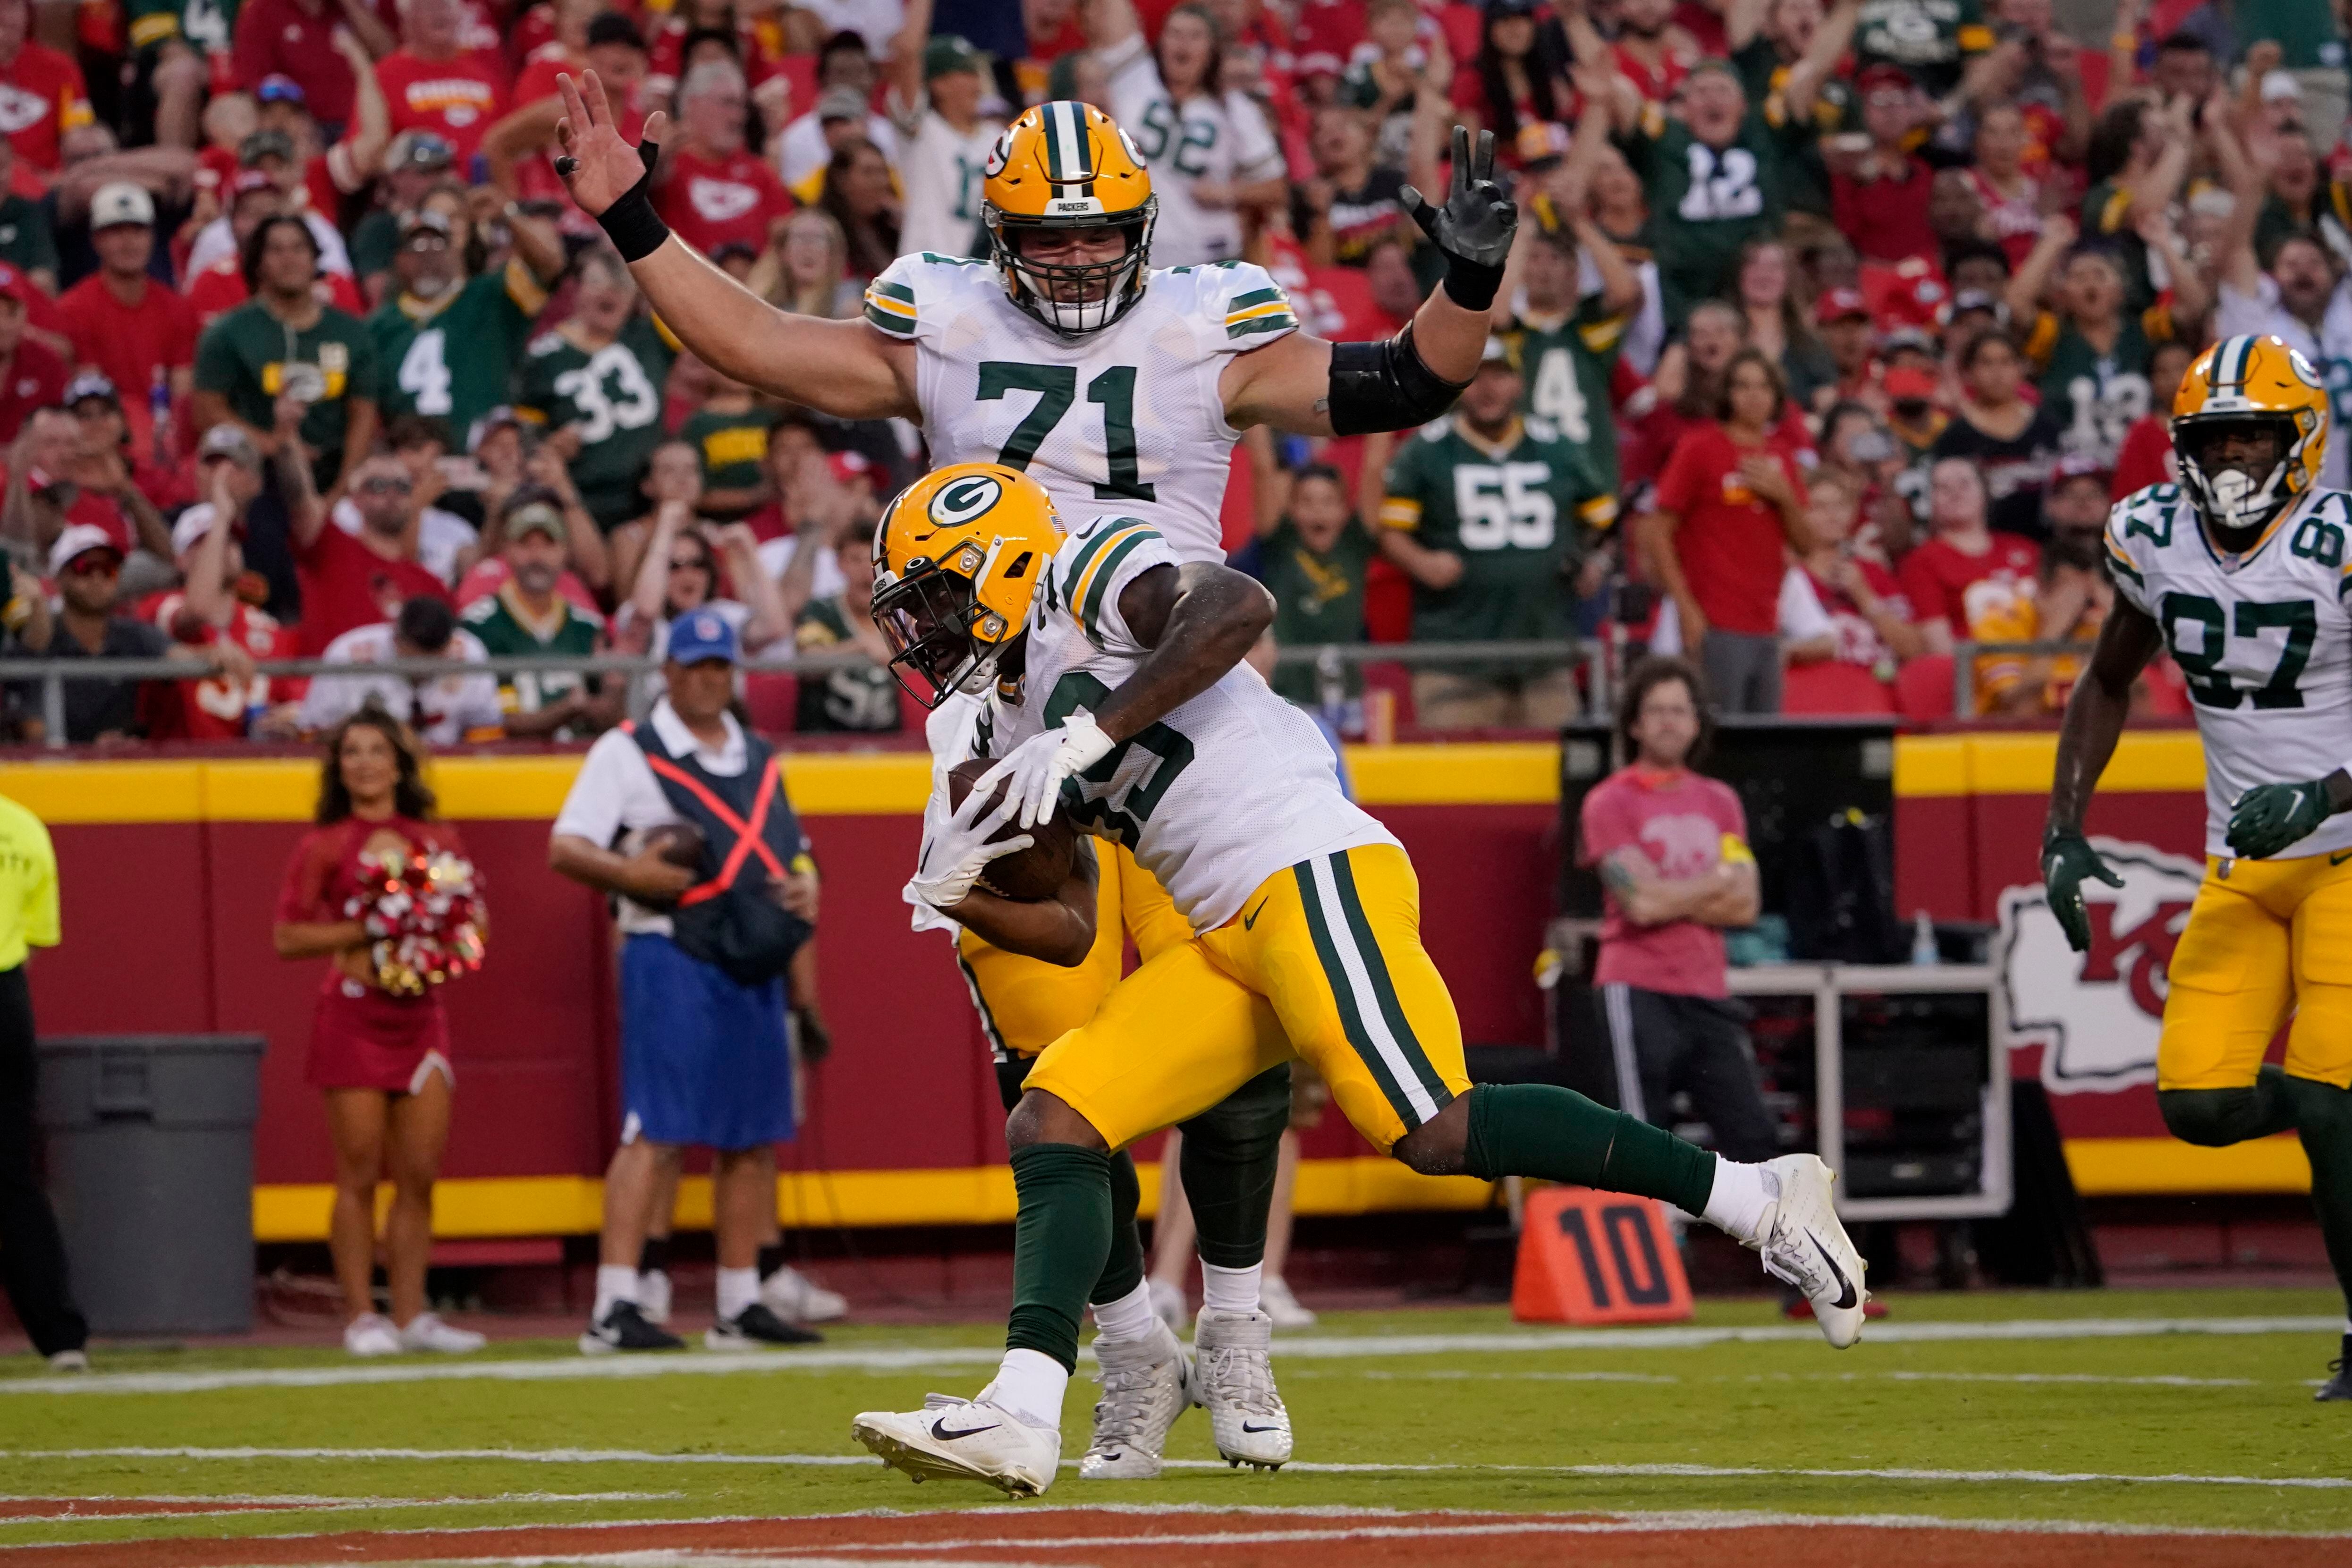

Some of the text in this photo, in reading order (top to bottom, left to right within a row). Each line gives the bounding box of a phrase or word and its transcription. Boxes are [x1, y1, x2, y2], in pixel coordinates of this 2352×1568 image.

[1139, 100, 1217, 177] 52
[1679, 143, 1763, 222] 12
[1058, 202, 1089, 212] PACKERS
[398, 328, 452, 415] 4
[554, 343, 659, 444] 33
[1532, 348, 1591, 443] 4
[975, 361, 1156, 502] 71
[1454, 461, 1556, 551] 55
[2162, 591, 2317, 709] 87
[1558, 1205, 1671, 1308] 10
